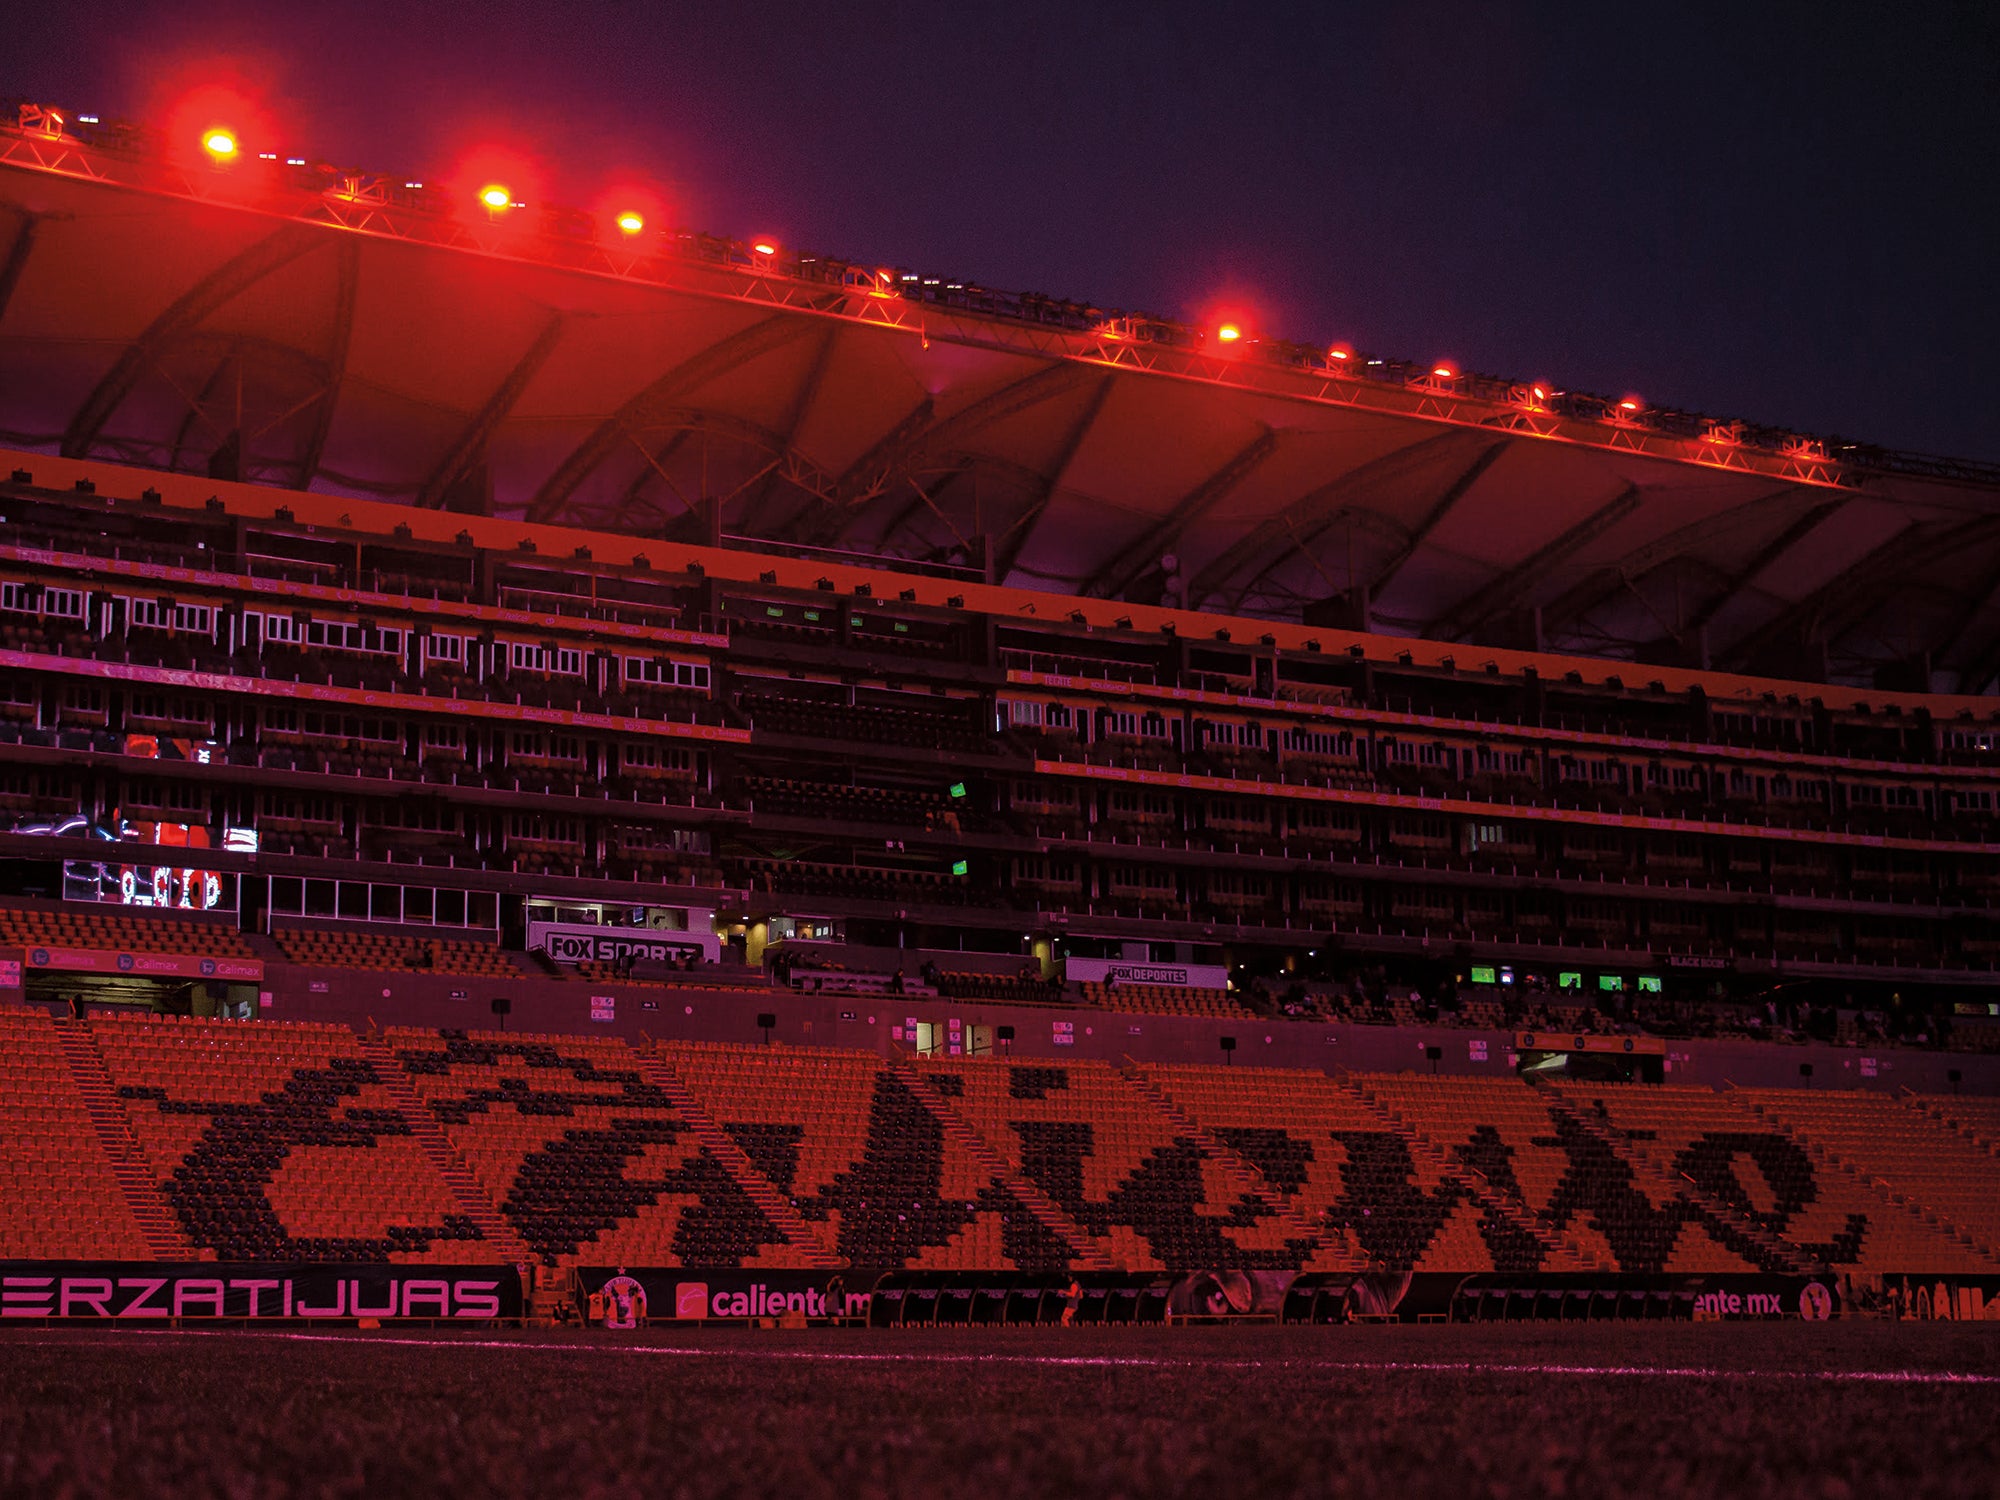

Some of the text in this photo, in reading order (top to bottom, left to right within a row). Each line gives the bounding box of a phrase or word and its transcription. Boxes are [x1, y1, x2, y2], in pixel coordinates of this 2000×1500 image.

[1043, 674, 1072, 687] TECATE
[551, 936, 592, 958] FOX
[134, 957, 180, 972] Calimax
[216, 962, 261, 977] Calimax
[1111, 967, 1187, 983] FOX DEPORTES
